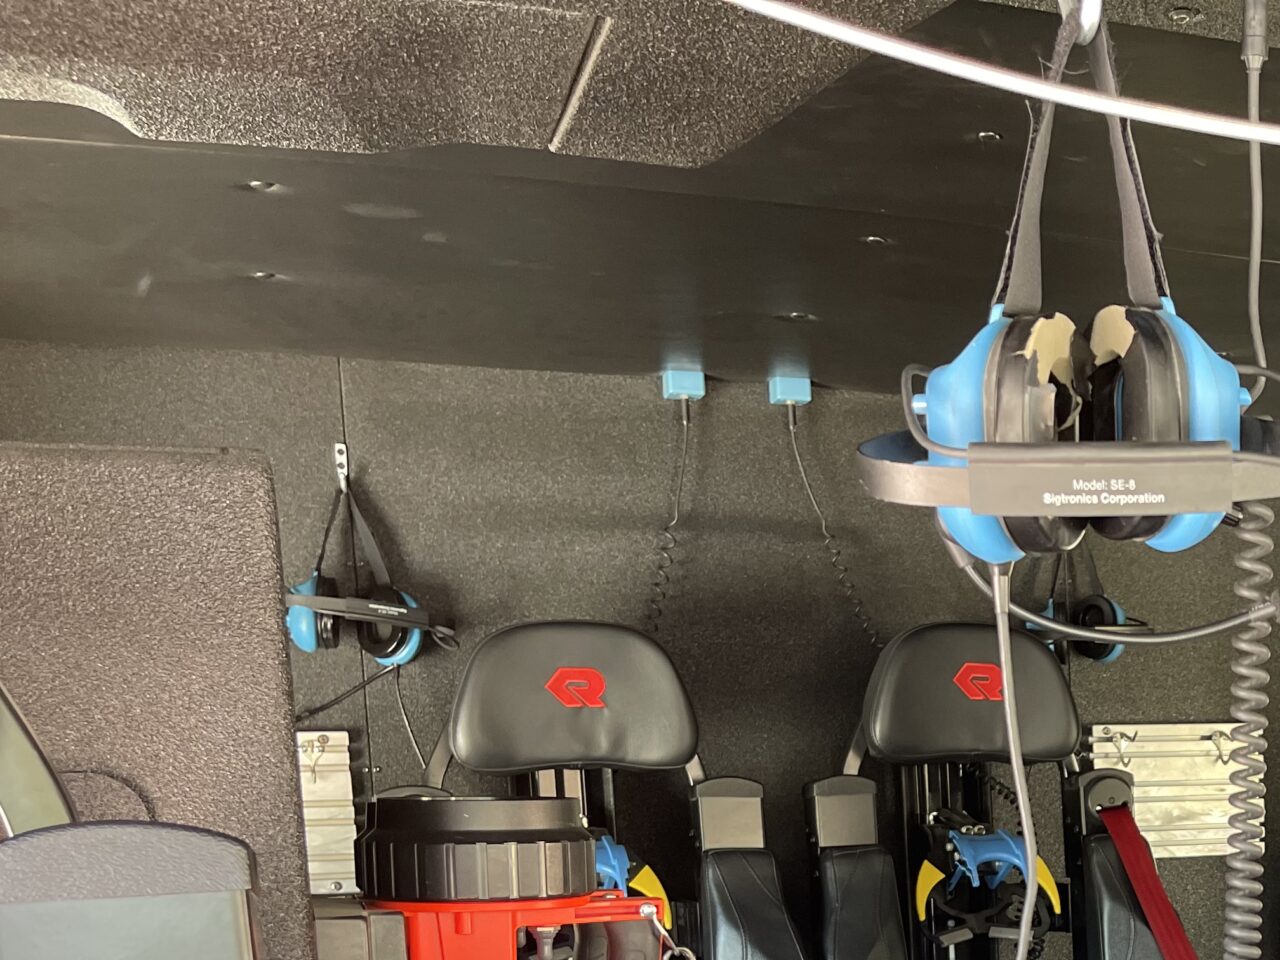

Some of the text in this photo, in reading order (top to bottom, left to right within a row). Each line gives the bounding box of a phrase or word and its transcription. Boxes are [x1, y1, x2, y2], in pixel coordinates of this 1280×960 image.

[1073, 479, 1107, 490] Model:
[1043, 492, 1165, 506] Sigtronics Corporation
